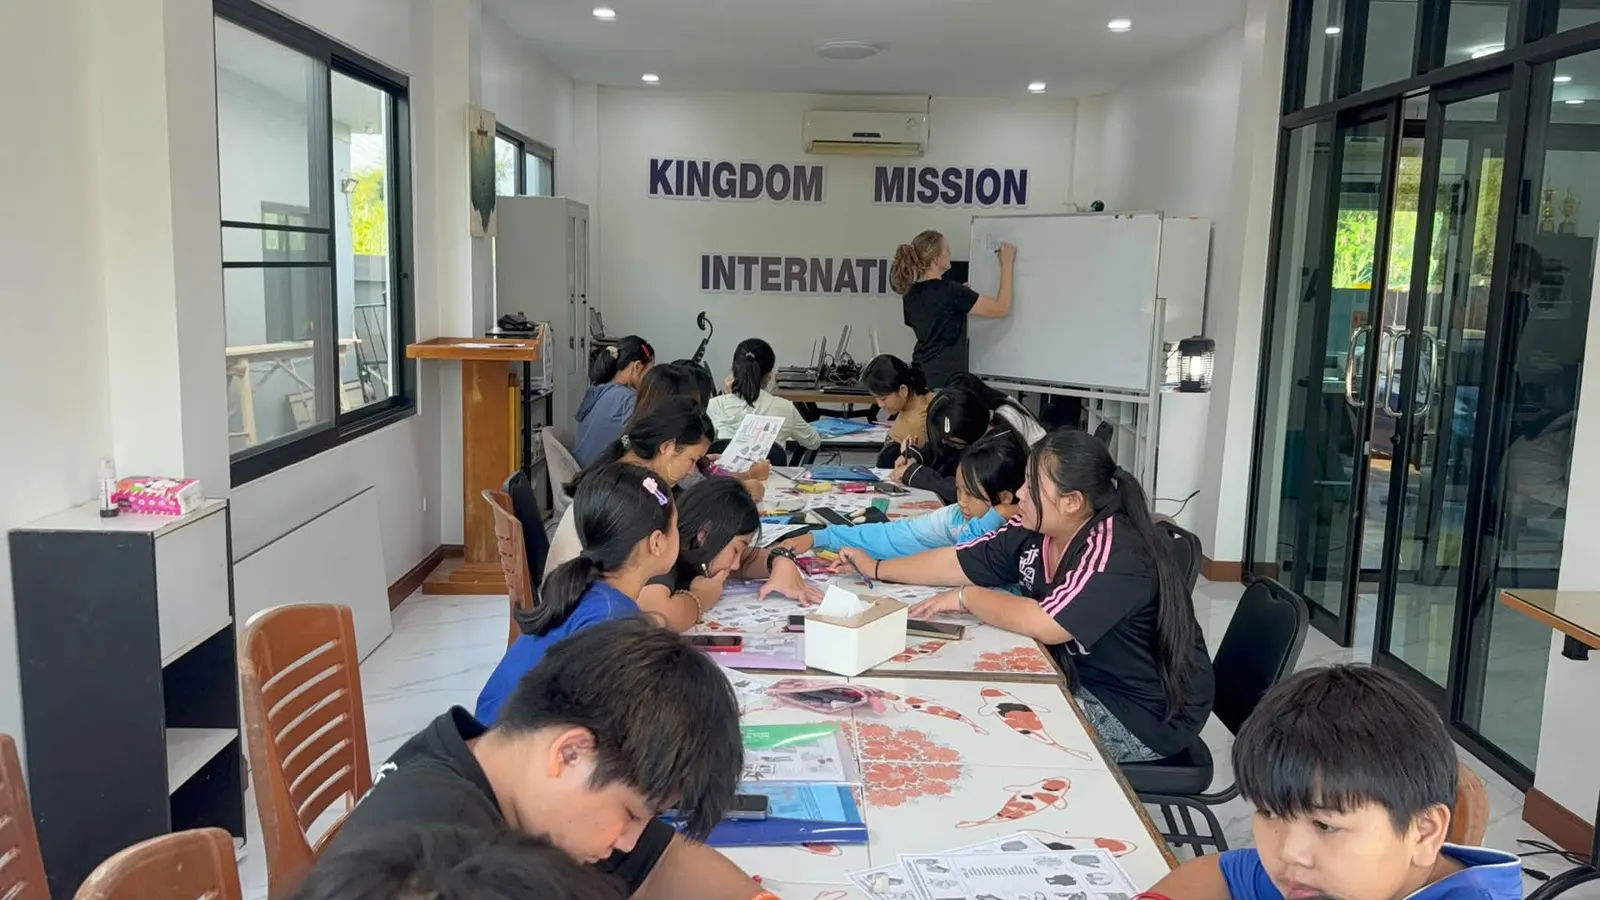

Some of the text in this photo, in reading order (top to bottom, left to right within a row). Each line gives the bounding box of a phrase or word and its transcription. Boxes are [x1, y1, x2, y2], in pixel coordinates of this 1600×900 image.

[649, 158, 1028, 205] KINGDOM MISSION
[701, 254, 899, 295] INTERNATI
